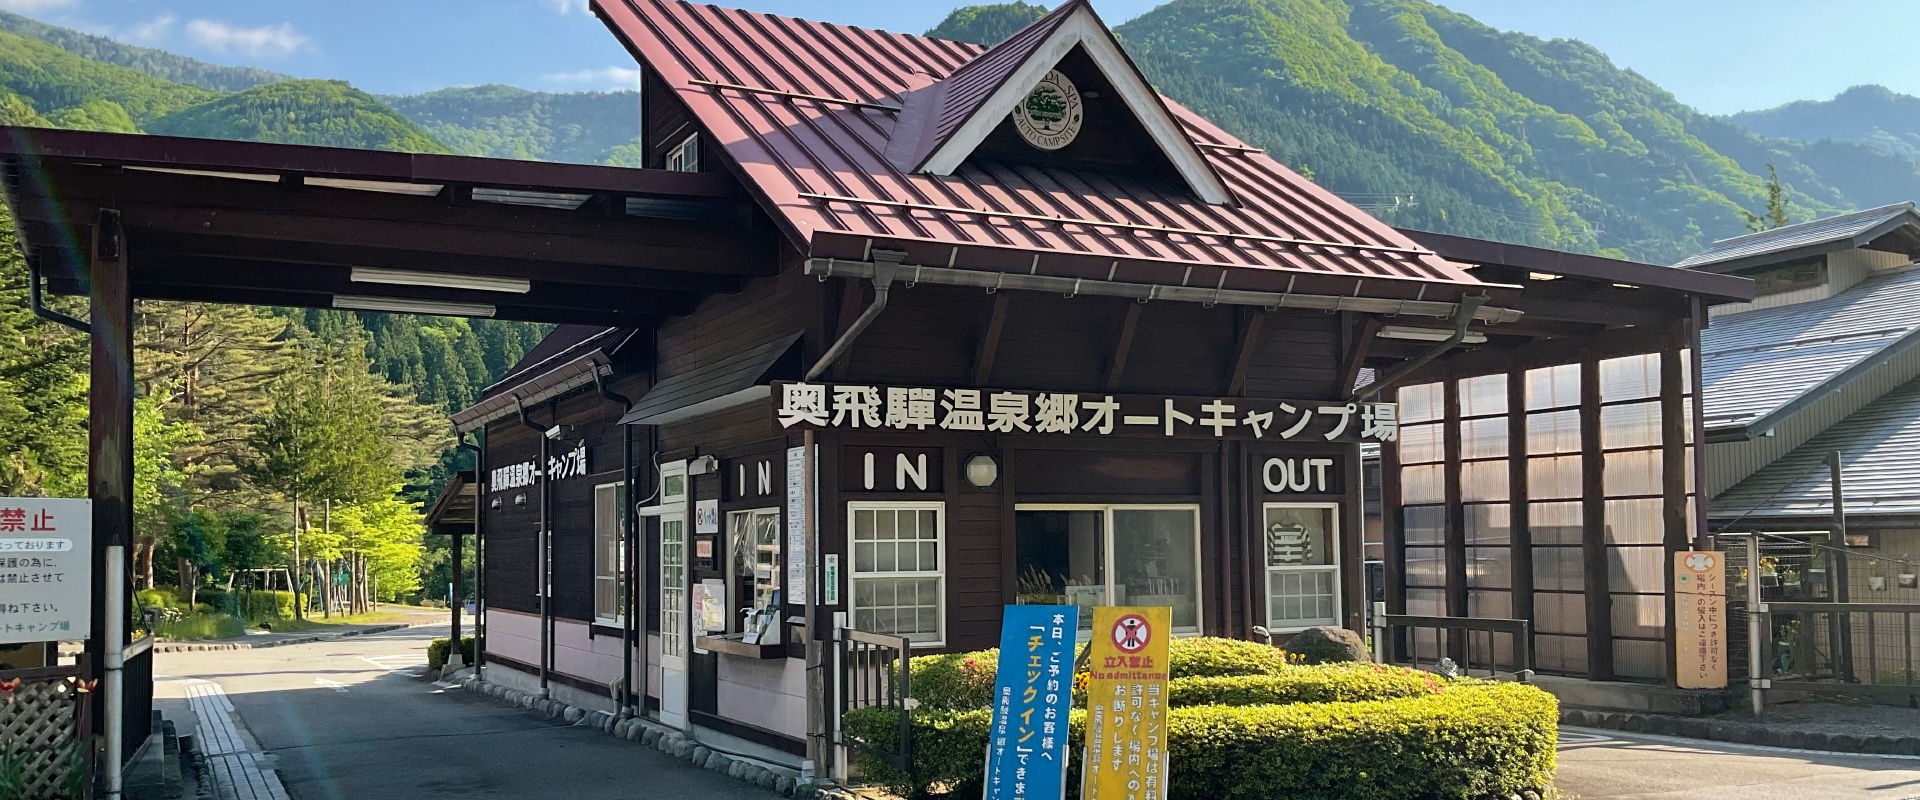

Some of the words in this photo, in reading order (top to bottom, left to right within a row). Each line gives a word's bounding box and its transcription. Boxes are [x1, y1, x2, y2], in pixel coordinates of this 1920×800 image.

[1067, 85, 1079, 110] SPA
[1017, 118, 1037, 140] AUTO
[491, 446, 587, 493] 奥飛騨温泉郷オーキャンプ場
[739, 460, 772, 496] IN
[863, 452, 927, 491] IN
[1263, 457, 1333, 493] OUT
[0, 508, 56, 533] 禁止
[0, 621, 70, 634] トキャンプ場
[1090, 670, 1105, 680] No
[1106, 670, 1167, 680] admittance
[1104, 655, 1154, 669] 立入禁止
[1041, 613, 1064, 761] 本日、ご予約のお客様へ
[1014, 625, 1045, 800] 「チェックイン」できま
[1112, 684, 1127, 771] お断りします
